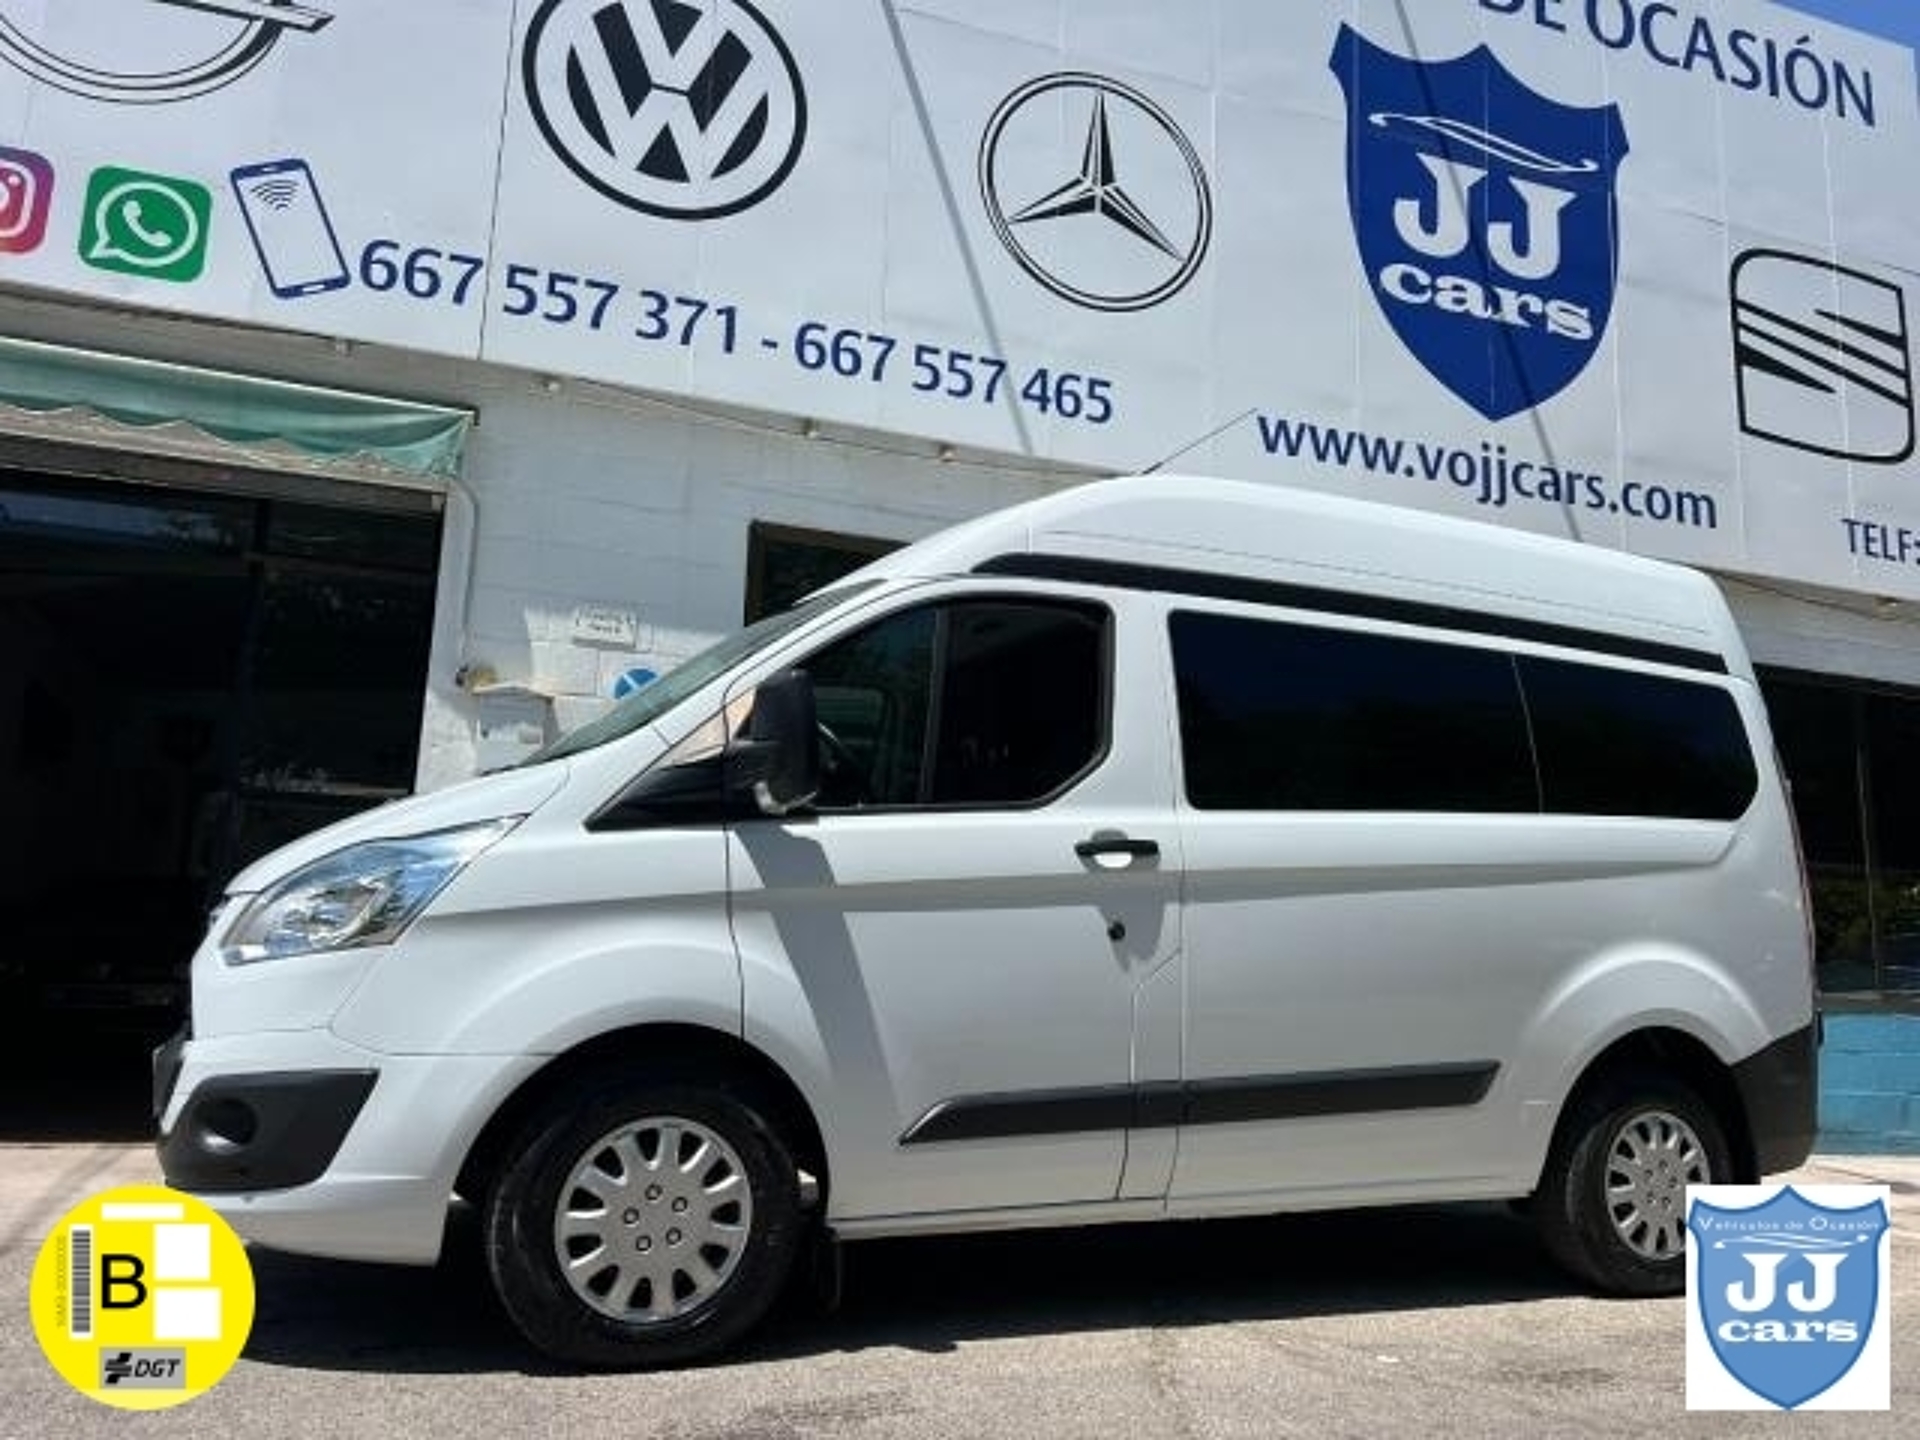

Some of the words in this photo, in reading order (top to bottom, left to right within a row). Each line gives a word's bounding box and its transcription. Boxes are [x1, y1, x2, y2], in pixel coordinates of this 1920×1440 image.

[1584, 0, 1875, 127] OCASIÓN
[359, 239, 484, 305] 667
[502, 263, 620, 330] 557
[635, 289, 736, 354] 371
[794, 322, 896, 382] 667
[912, 344, 1008, 403] 557
[1021, 368, 1112, 424] 465
[1380, 263, 1594, 341] cars
[1257, 415, 1717, 529] www.vojjcars.com
